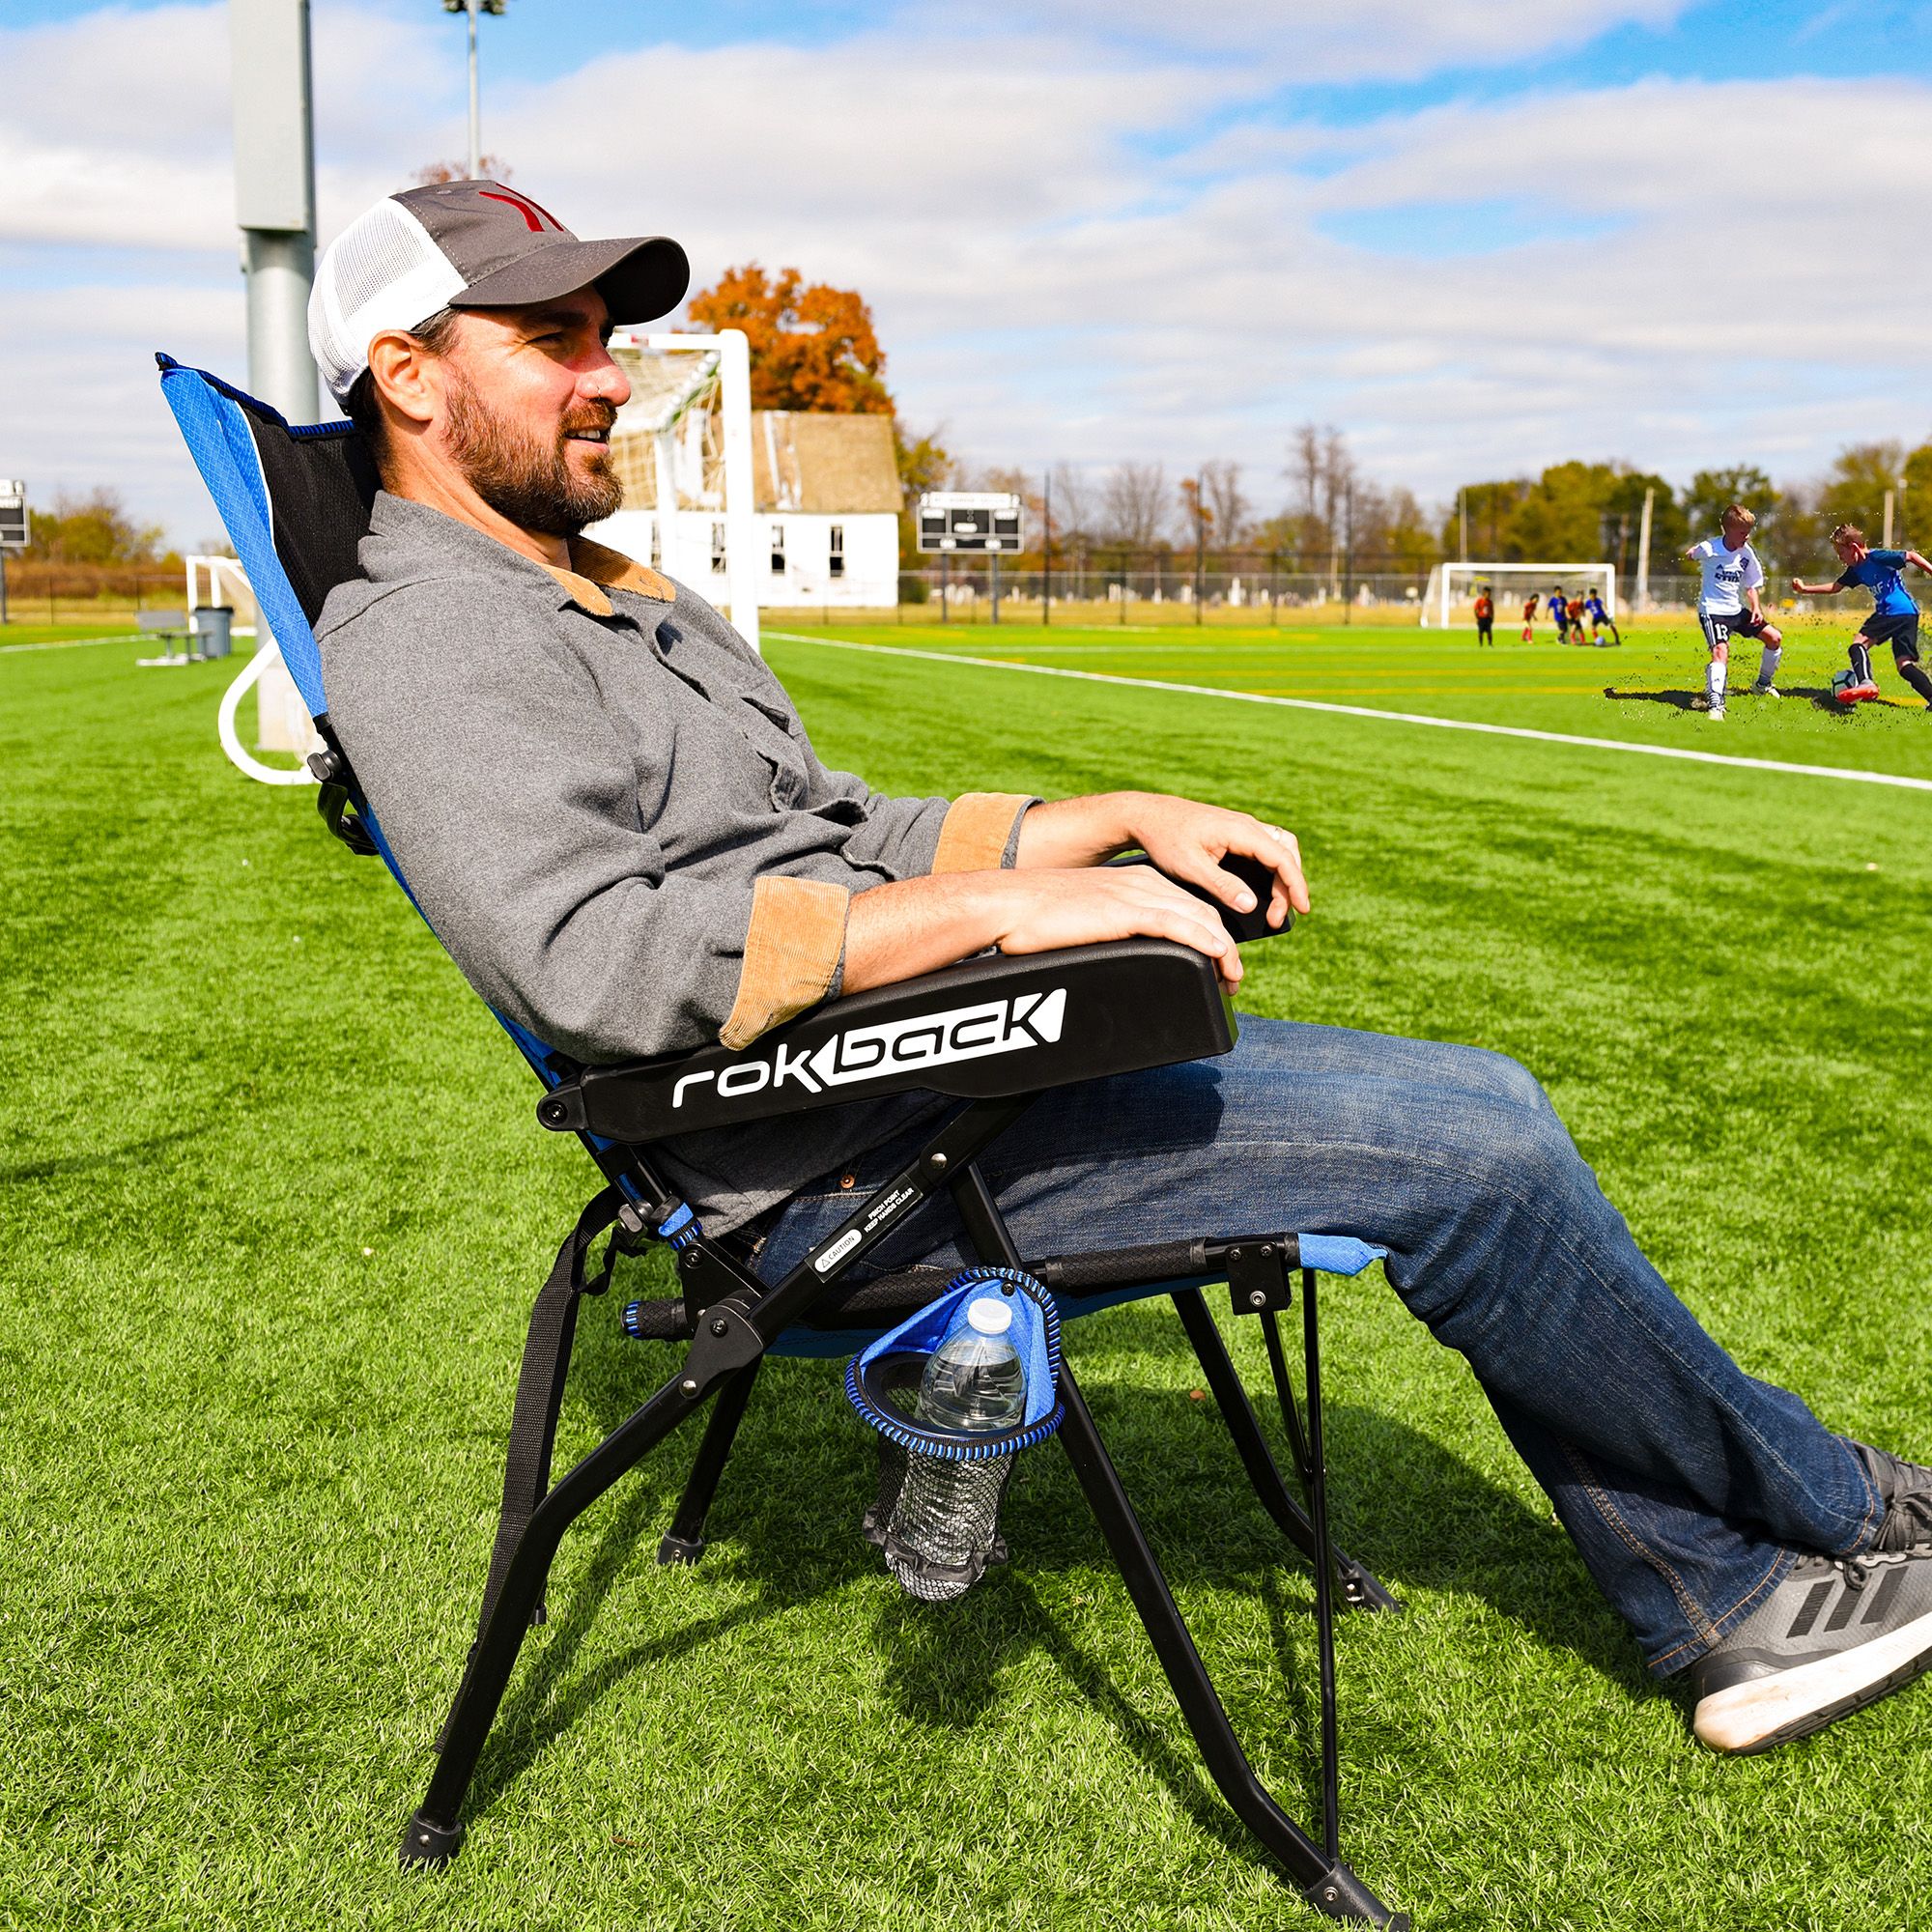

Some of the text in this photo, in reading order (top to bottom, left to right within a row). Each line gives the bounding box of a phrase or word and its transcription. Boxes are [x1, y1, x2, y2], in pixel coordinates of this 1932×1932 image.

[1715, 623, 1728, 641] 13
[864, 1187, 915, 1233] KEEP HANDS CLEAR
[867, 1189, 900, 1220] PINCH POINT
[828, 1236, 855, 1261] CAUTION
